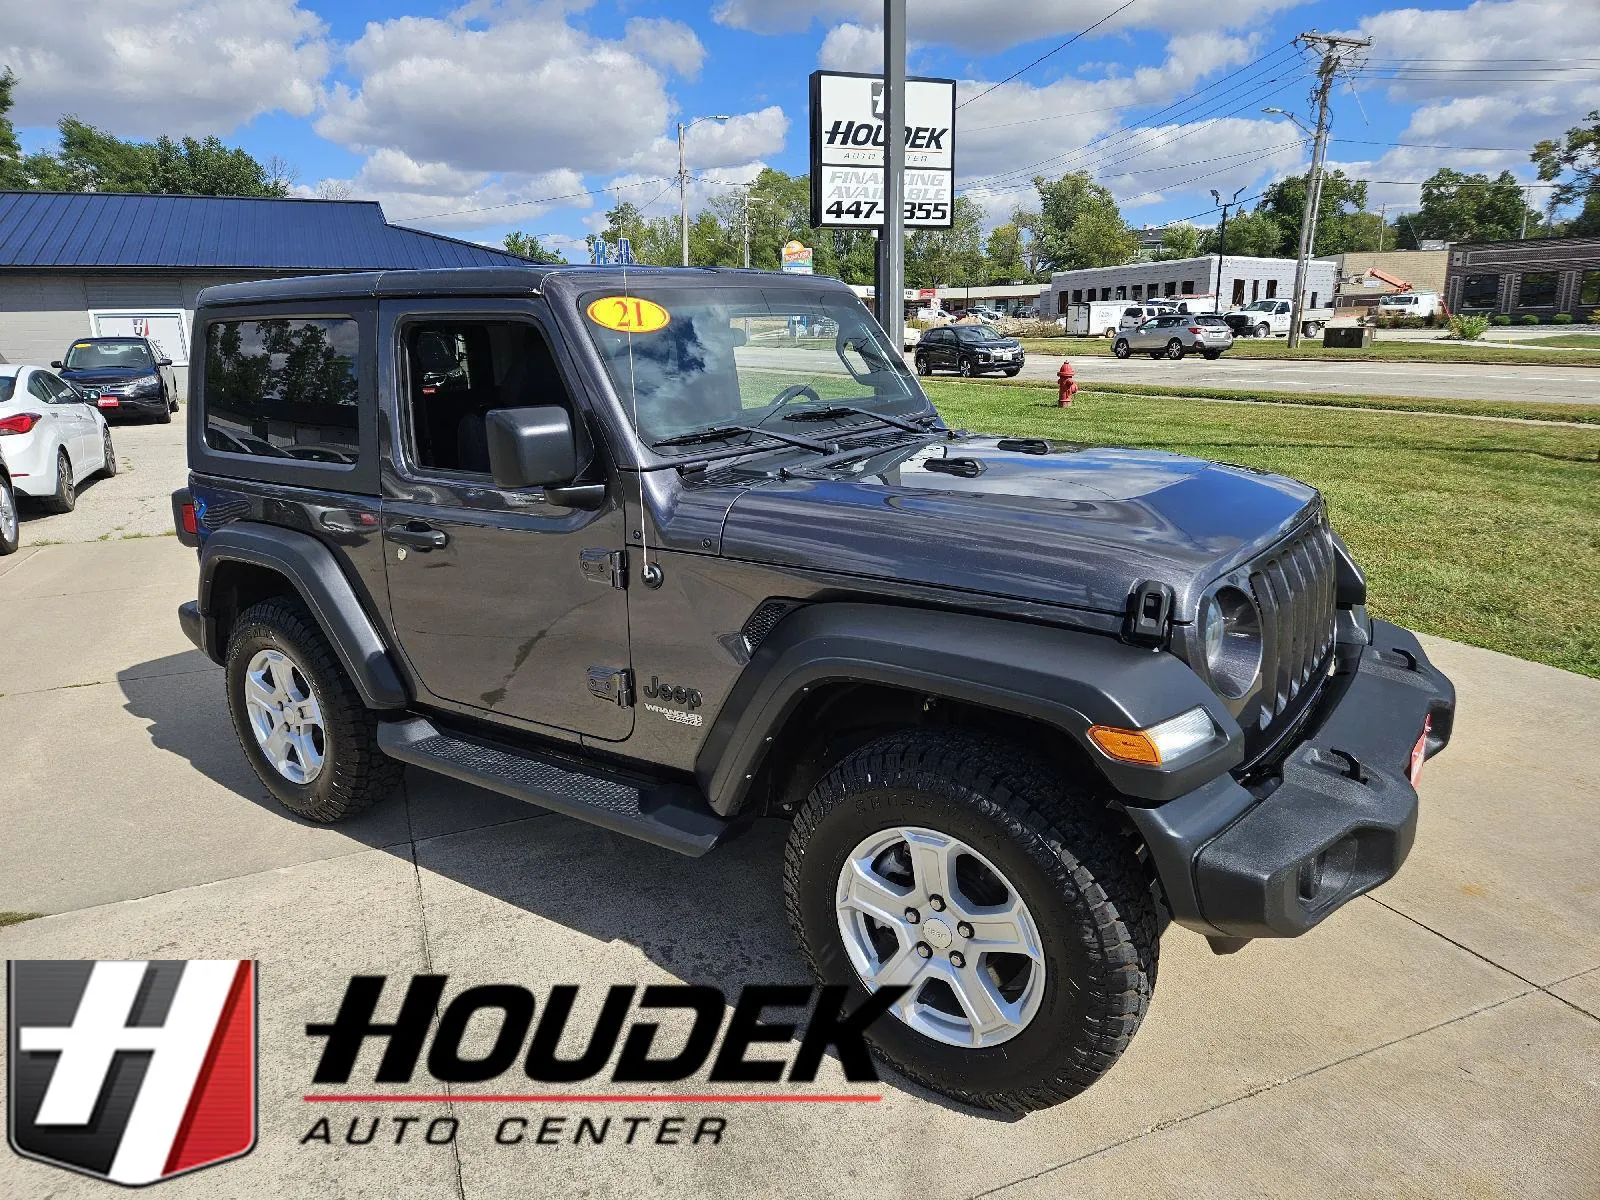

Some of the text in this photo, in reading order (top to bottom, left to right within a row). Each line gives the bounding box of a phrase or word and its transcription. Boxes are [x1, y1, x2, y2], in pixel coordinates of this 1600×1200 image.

[829, 170, 945, 187] FINAING
[827, 185, 946, 201] AVAIBLE
[825, 200, 949, 220] 447-355
[613, 300, 644, 327] 21
[643, 675, 703, 711] Jeep
